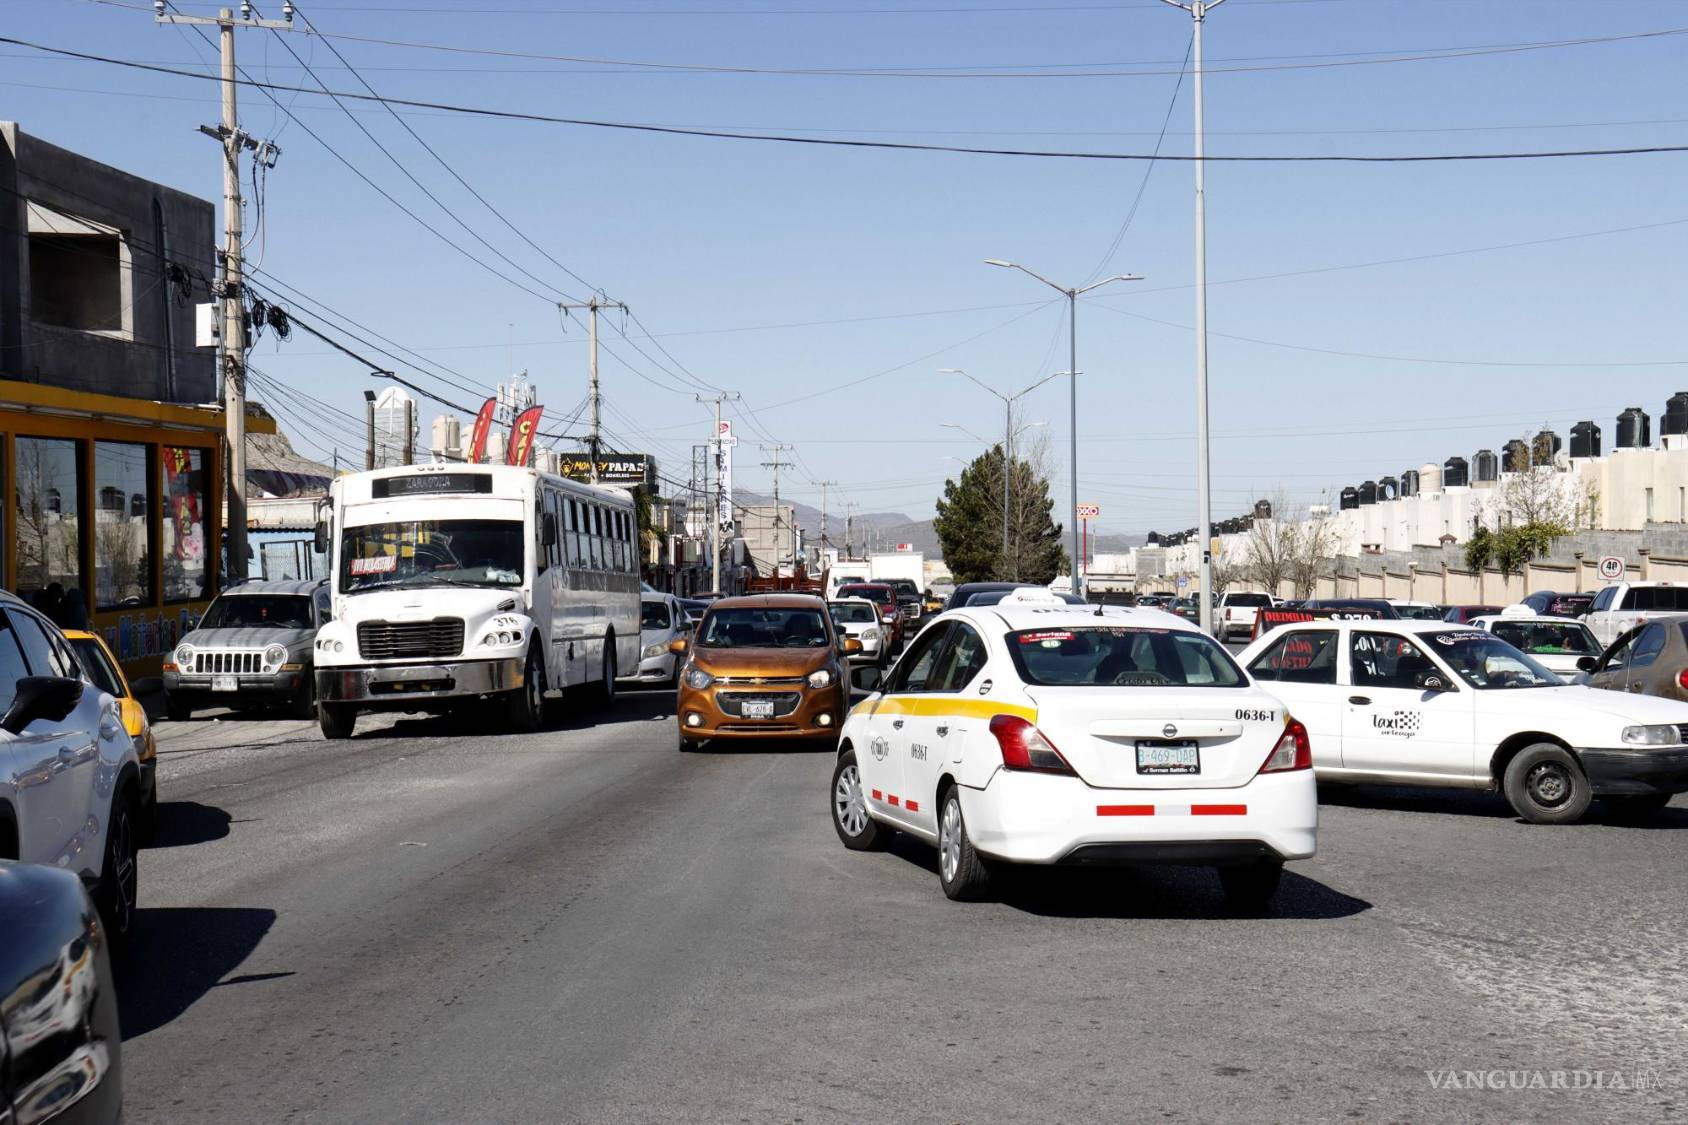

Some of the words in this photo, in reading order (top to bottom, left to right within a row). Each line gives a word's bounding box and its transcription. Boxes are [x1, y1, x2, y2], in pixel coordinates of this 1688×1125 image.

[574, 461, 608, 471] MONEY
[1077, 506, 1098, 515] XXO
[1606, 561, 1618, 571] 40
[1235, 709, 1275, 722] 0636-T
